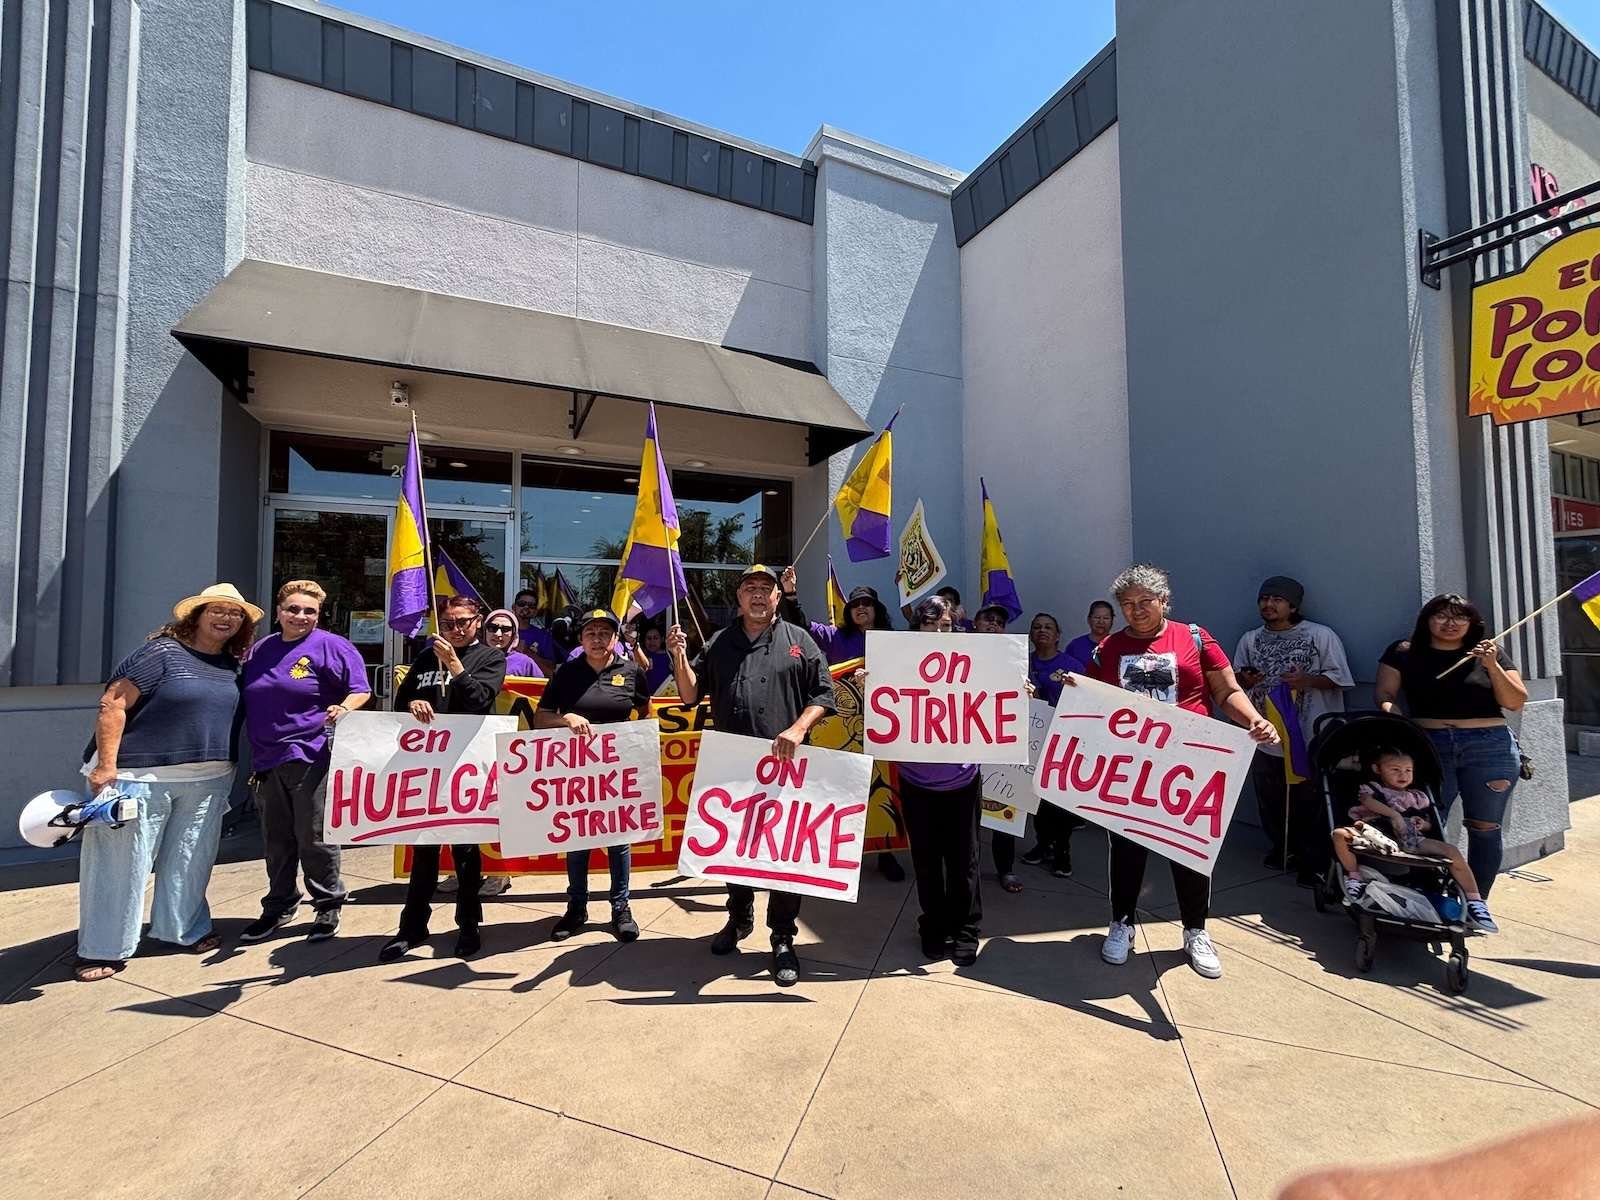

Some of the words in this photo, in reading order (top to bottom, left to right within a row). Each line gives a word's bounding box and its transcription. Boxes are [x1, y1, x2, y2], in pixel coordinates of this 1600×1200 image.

[919, 651, 971, 683] on
[866, 686, 1019, 744] STRIKE
[1108, 708, 1172, 749] en
[399, 729, 451, 753] en
[503, 733, 620, 775] STRIKE
[526, 767, 642, 811] STRIKE
[756, 755, 808, 788] ON
[1040, 733, 1227, 838] HUELGA
[331, 760, 499, 829] HUELGA
[547, 801, 659, 843] STRIKE
[687, 788, 866, 869] STRIKE
